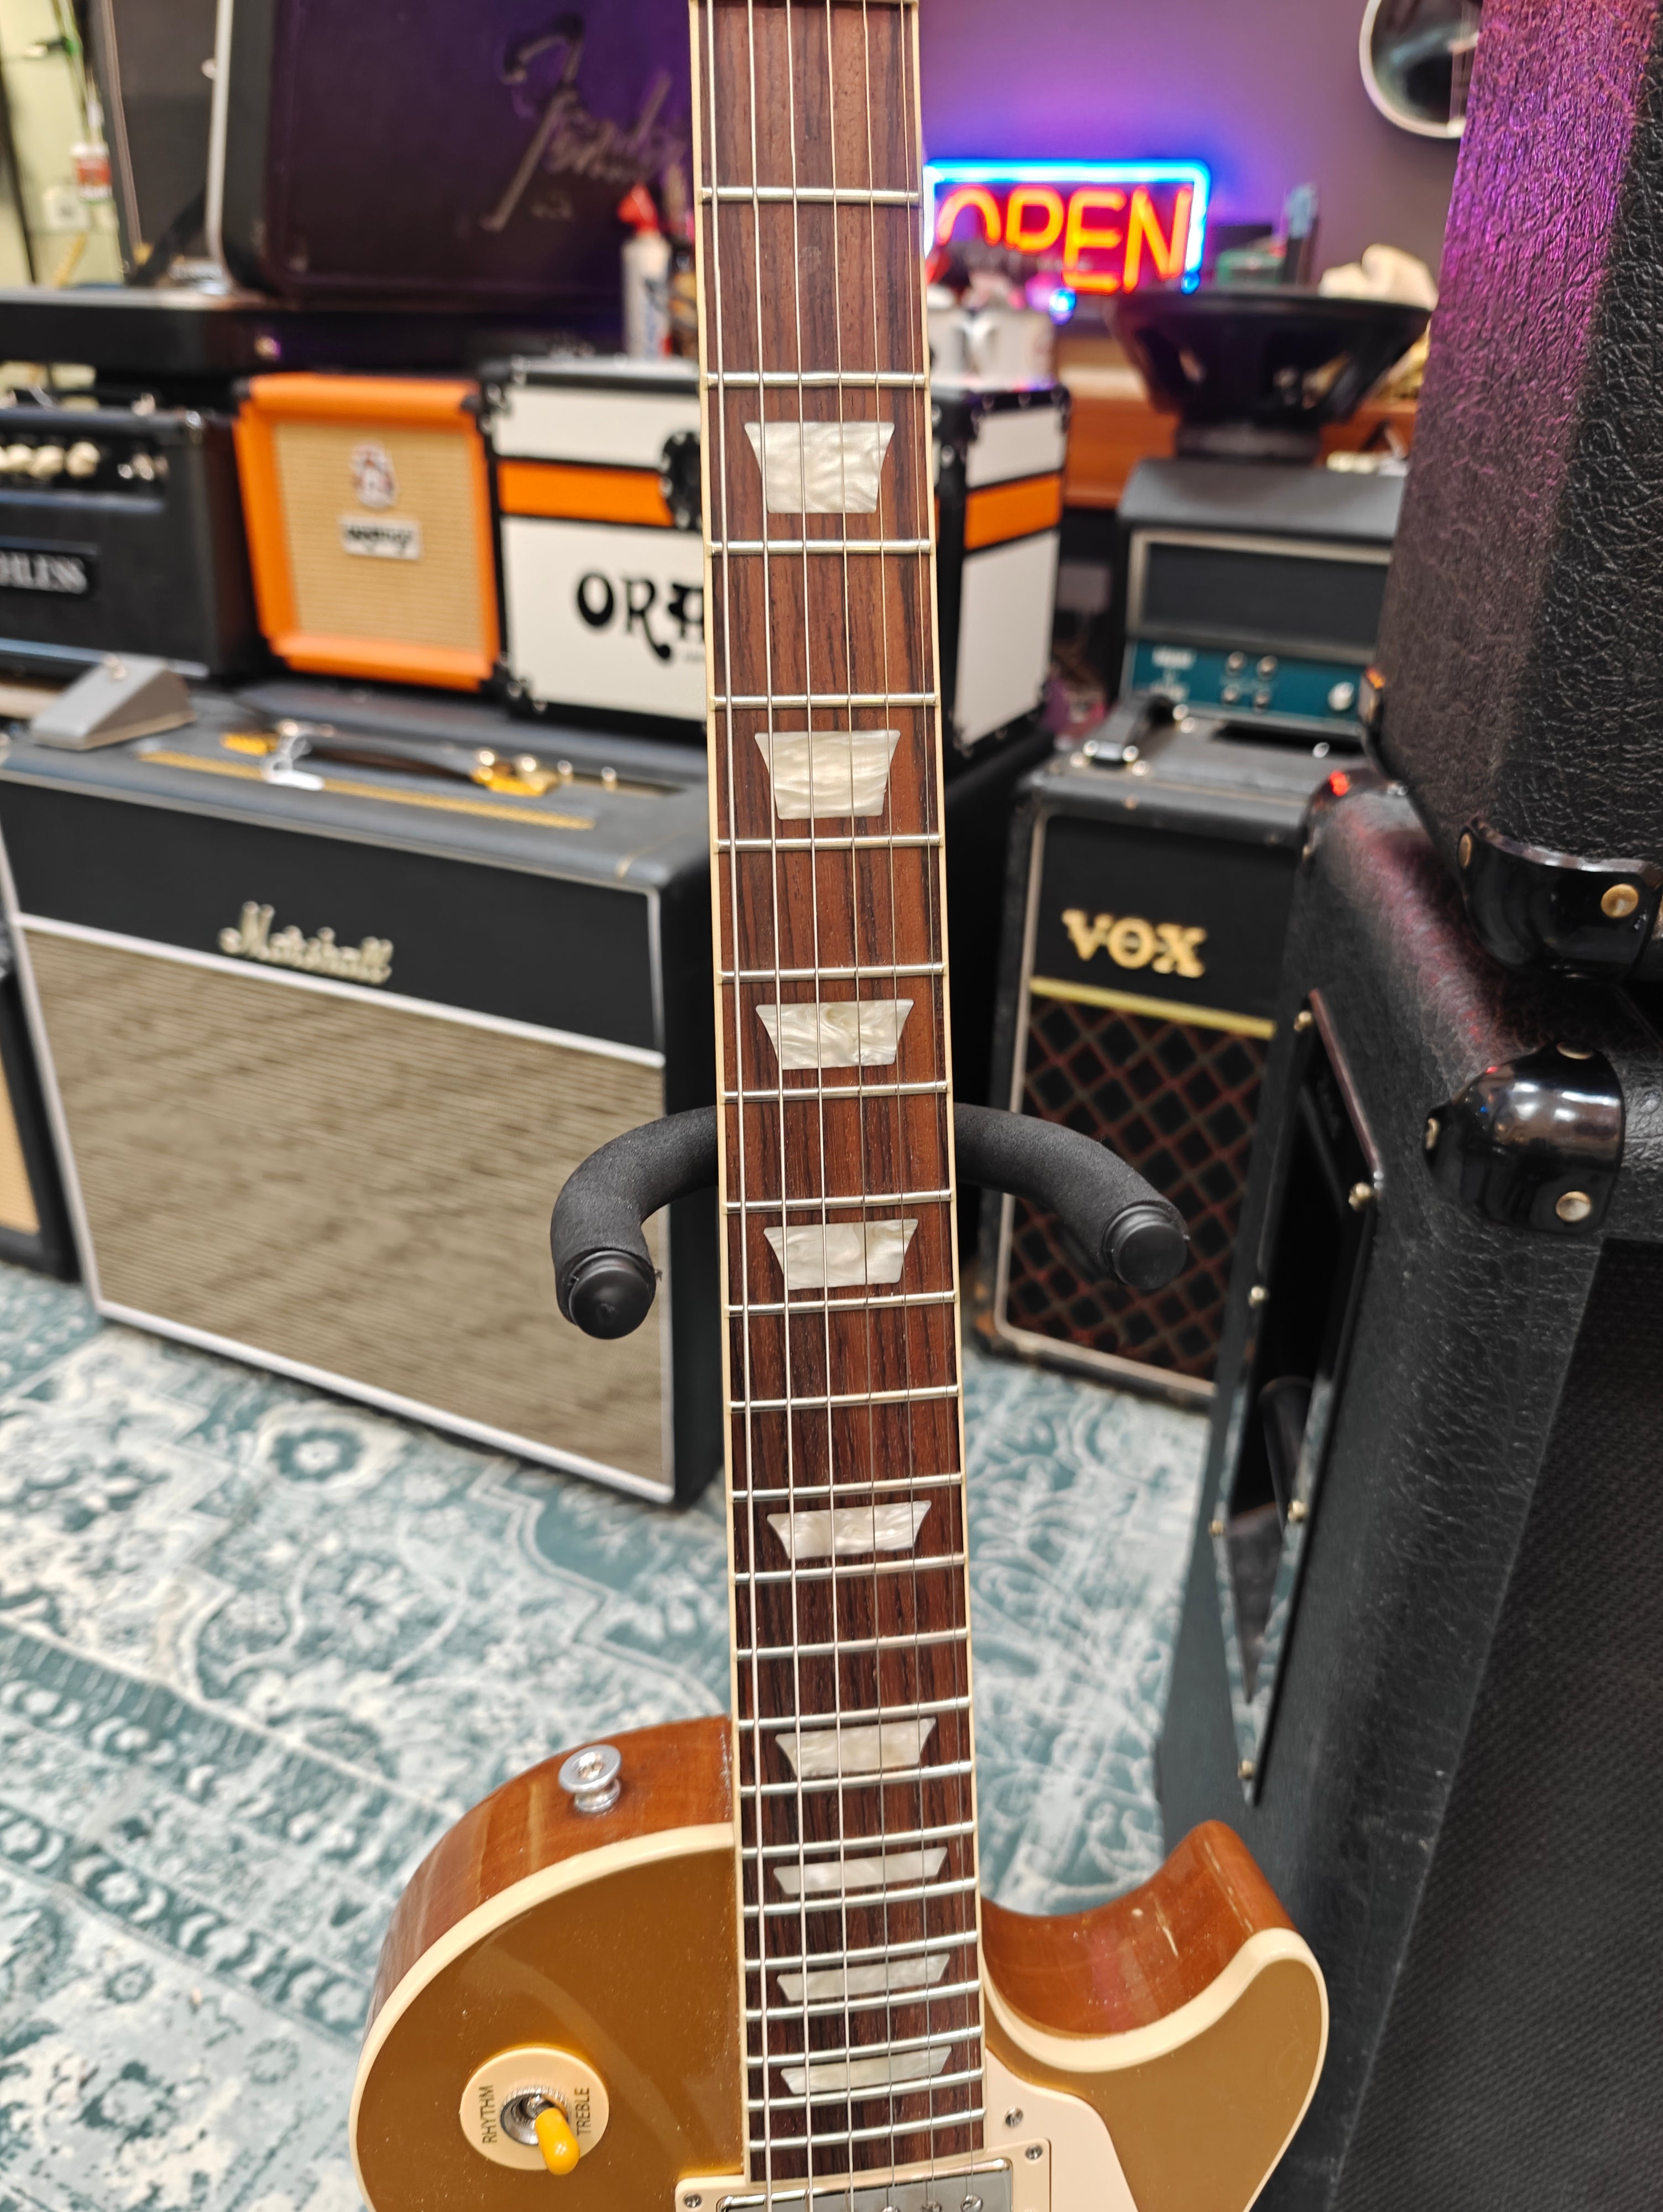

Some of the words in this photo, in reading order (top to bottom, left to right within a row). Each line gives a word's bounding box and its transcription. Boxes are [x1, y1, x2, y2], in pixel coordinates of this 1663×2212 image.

[935, 184, 1192, 294] OPEN
[218, 900, 394, 984] Marshall
[1061, 908, 1207, 978] VOX
[479, 2085, 498, 2144] RHYTHM
[574, 2088, 592, 2136] TREBLE
